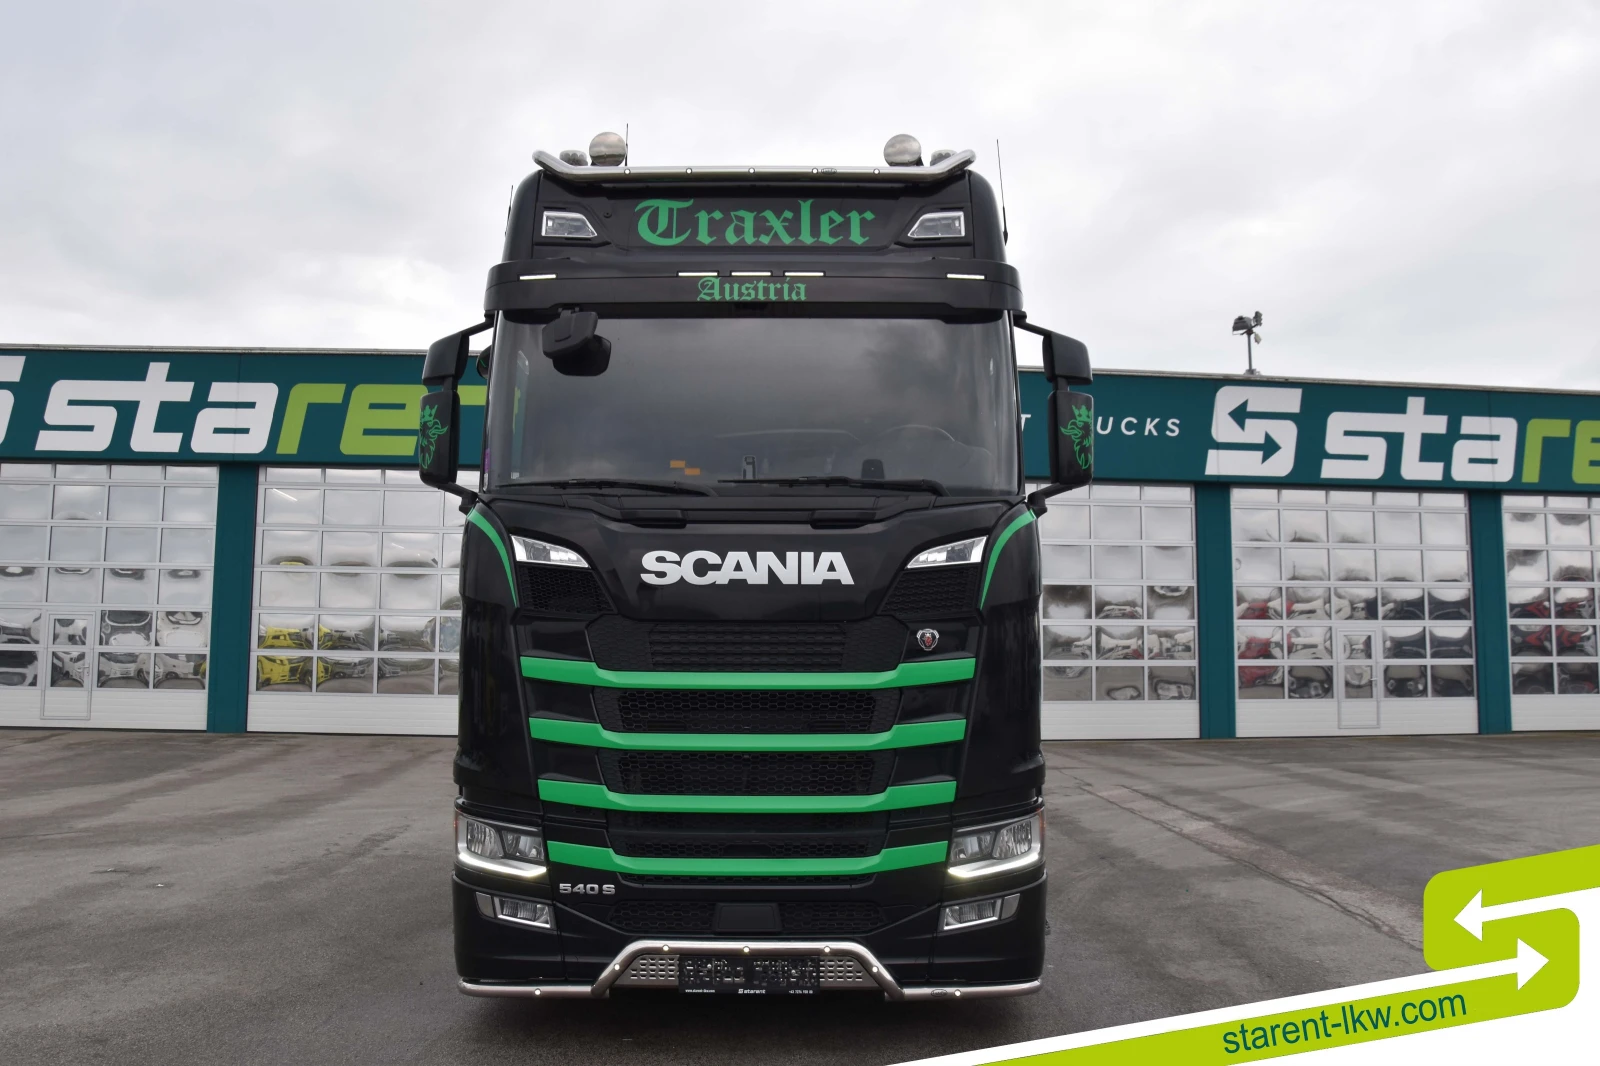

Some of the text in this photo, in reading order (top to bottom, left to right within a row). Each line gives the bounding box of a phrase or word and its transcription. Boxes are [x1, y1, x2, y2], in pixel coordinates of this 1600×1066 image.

[634, 198, 876, 246] Traxler
[697, 276, 807, 302] Austria
[35, 362, 487, 455] stare
[1096, 416, 1180, 437] UCKS
[640, 550, 855, 586] SCANIA
[559, 883, 616, 895] 540 S
